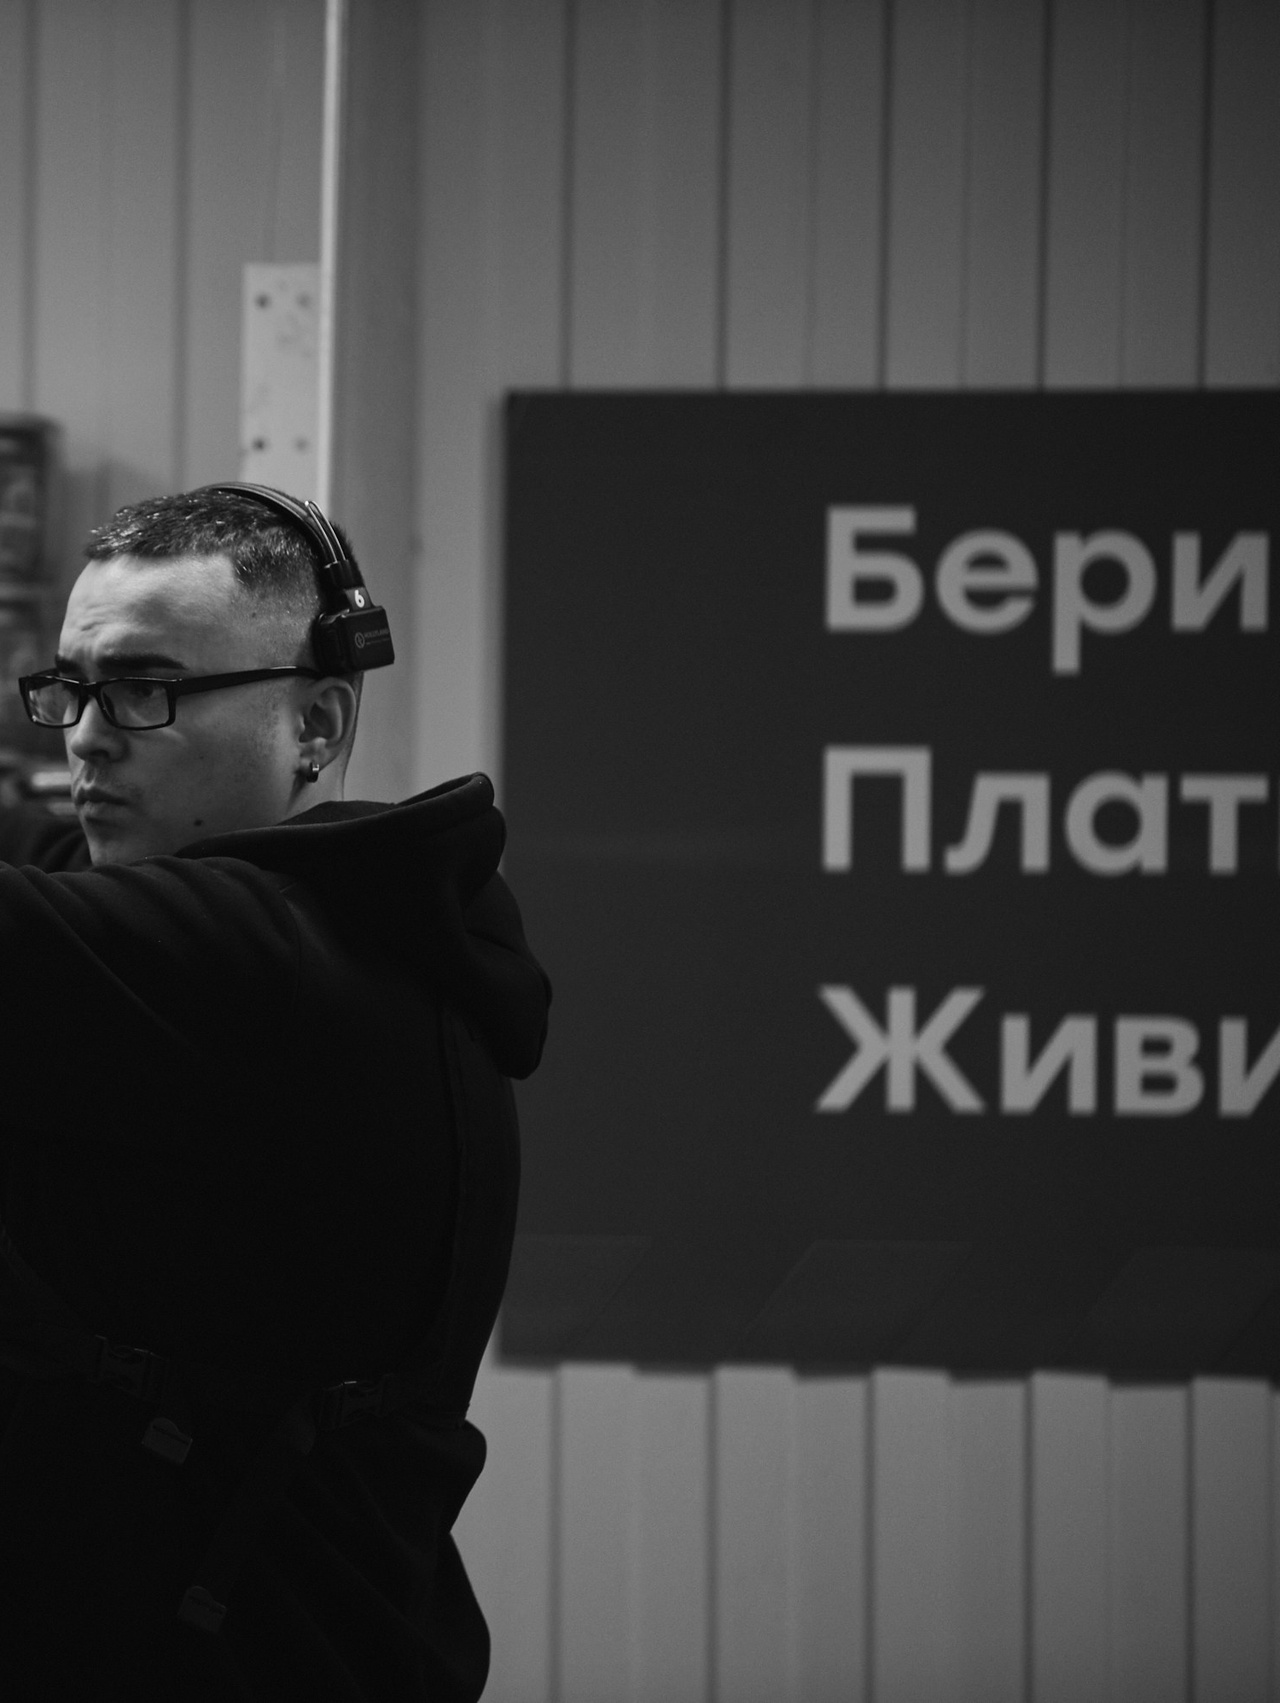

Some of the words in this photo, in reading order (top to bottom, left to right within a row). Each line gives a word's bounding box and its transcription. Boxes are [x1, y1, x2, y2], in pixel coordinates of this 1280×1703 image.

[354, 589, 365, 608] 6
[825, 503, 1271, 676] Бери
[823, 744, 1280, 877] Плат
